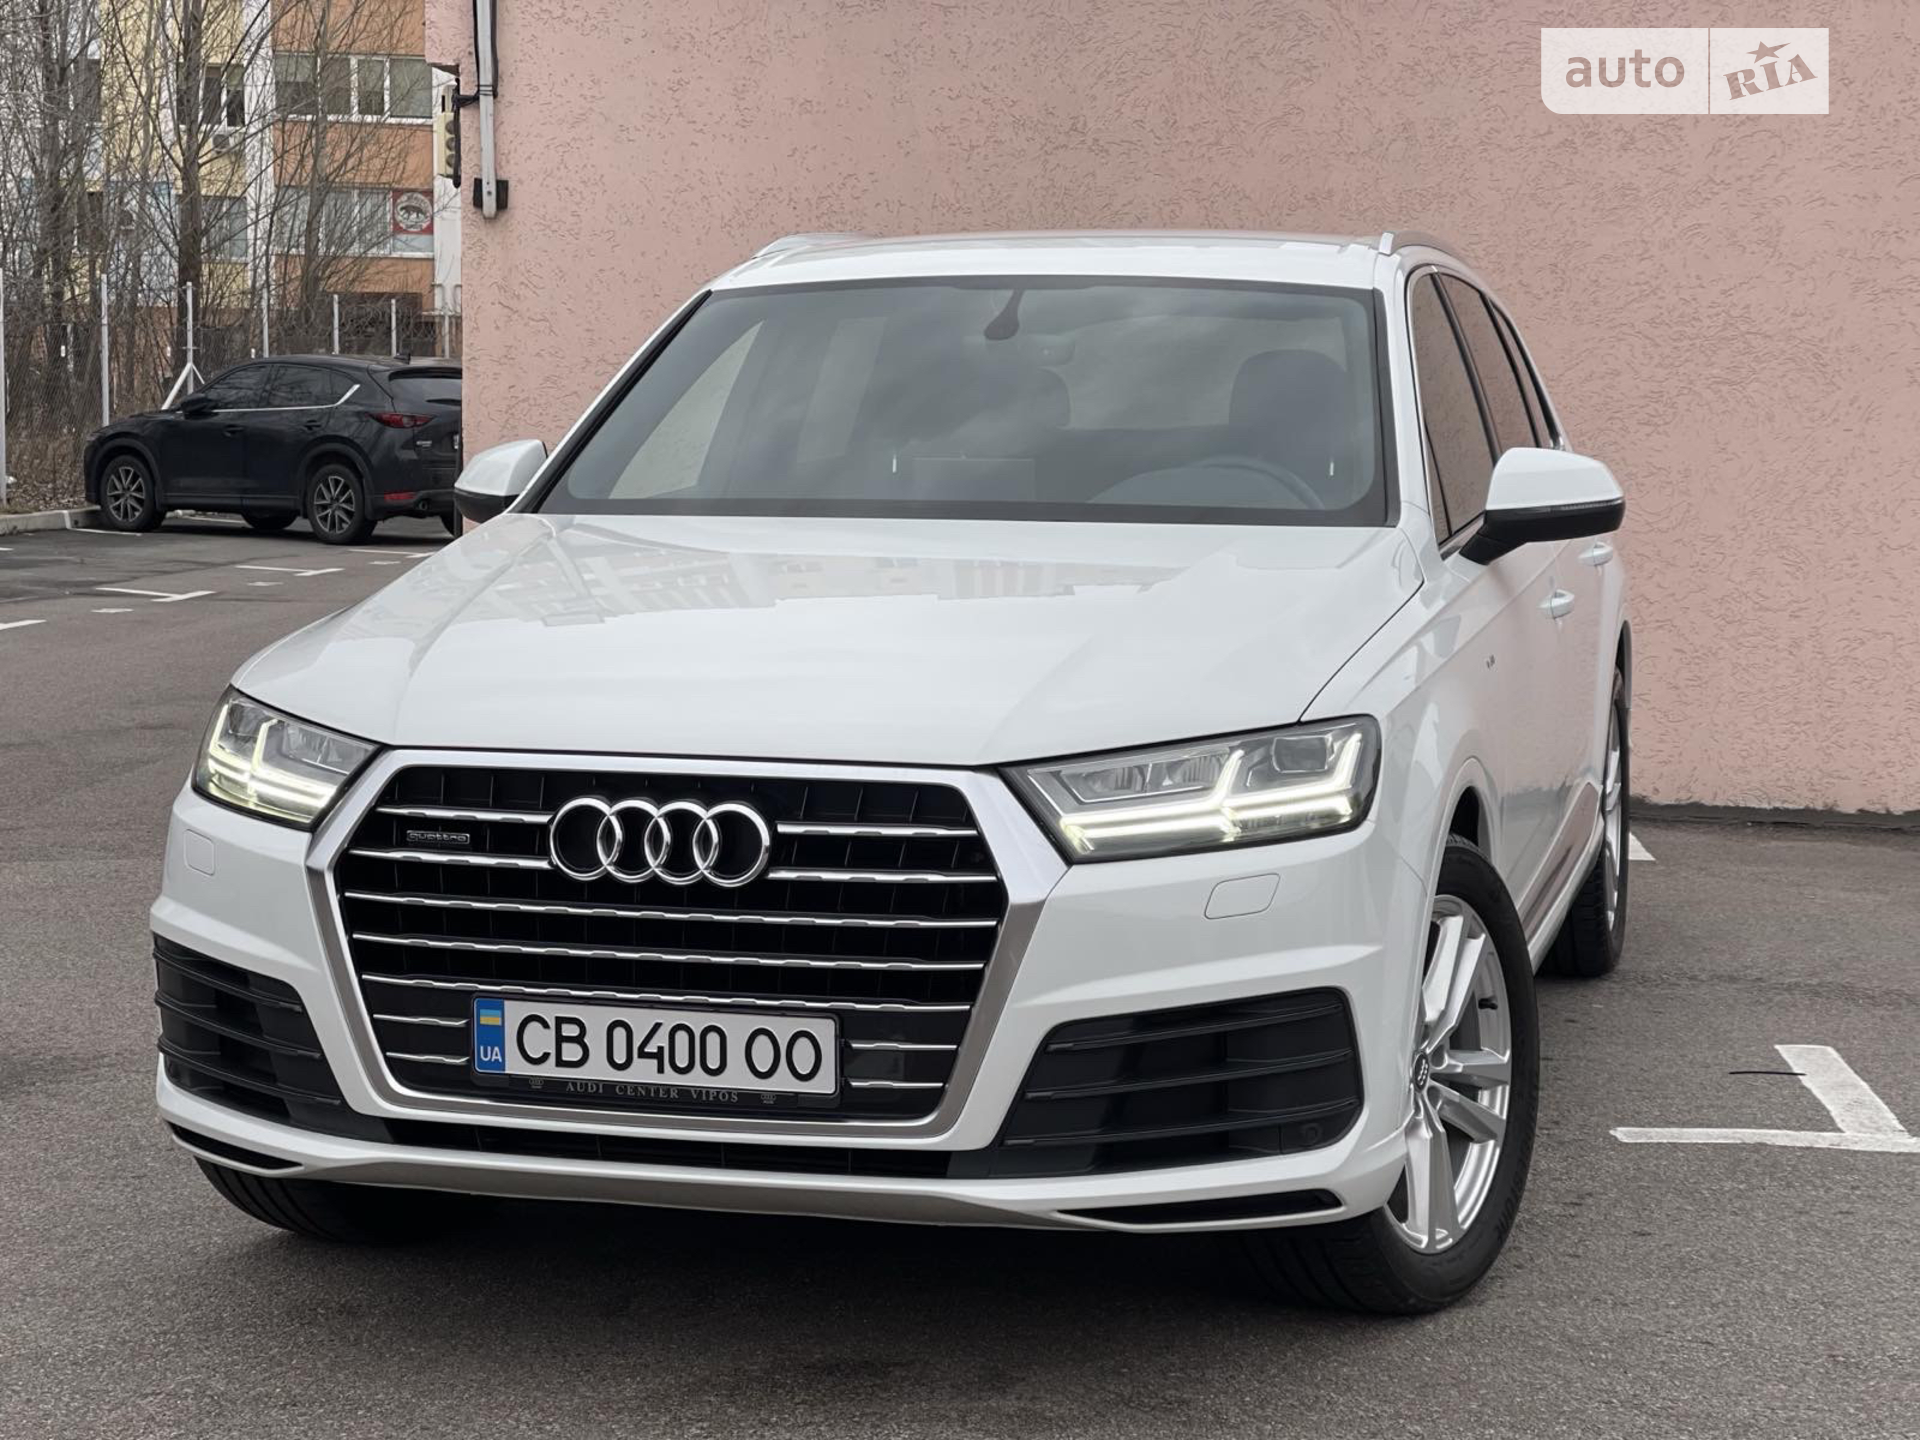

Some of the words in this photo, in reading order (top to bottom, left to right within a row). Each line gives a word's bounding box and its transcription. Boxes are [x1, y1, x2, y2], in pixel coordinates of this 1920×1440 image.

[480, 1046, 502, 1064] UA
[516, 1013, 590, 1069] CB
[606, 1019, 727, 1077] 0400
[745, 1027, 822, 1082] OO
[566, 1081, 604, 1094] AUDI
[615, 1084, 679, 1099] CENTER
[691, 1088, 738, 1102] VIPOS
